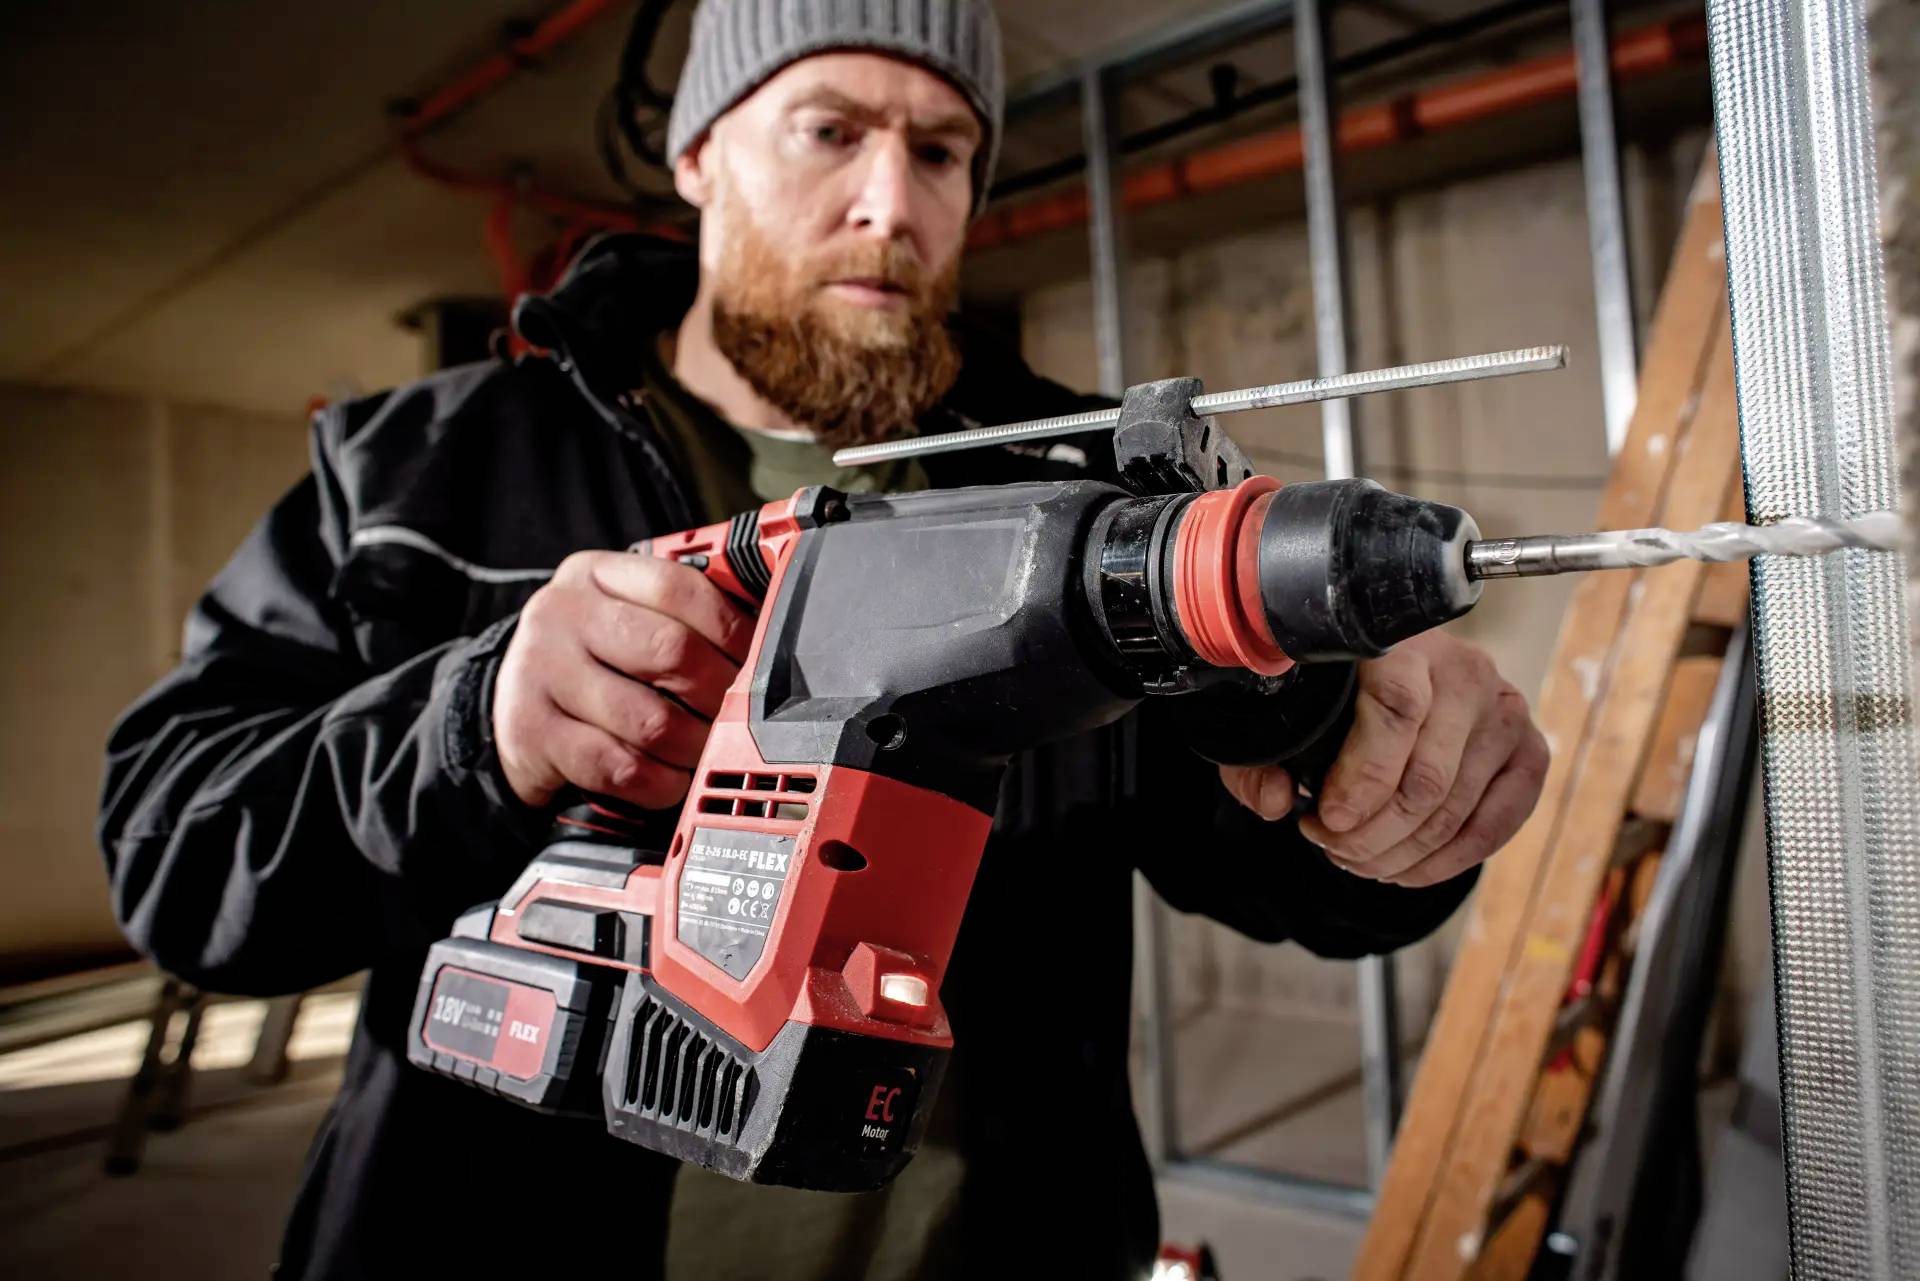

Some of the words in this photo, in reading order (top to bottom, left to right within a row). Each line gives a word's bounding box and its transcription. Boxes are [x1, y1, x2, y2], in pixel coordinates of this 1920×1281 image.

[748, 850, 788, 872] FLEX
[433, 995, 466, 1026] 18V
[508, 1020, 540, 1044] FLEX
[865, 1085, 902, 1122] EC
[861, 1124, 889, 1138] Motor
